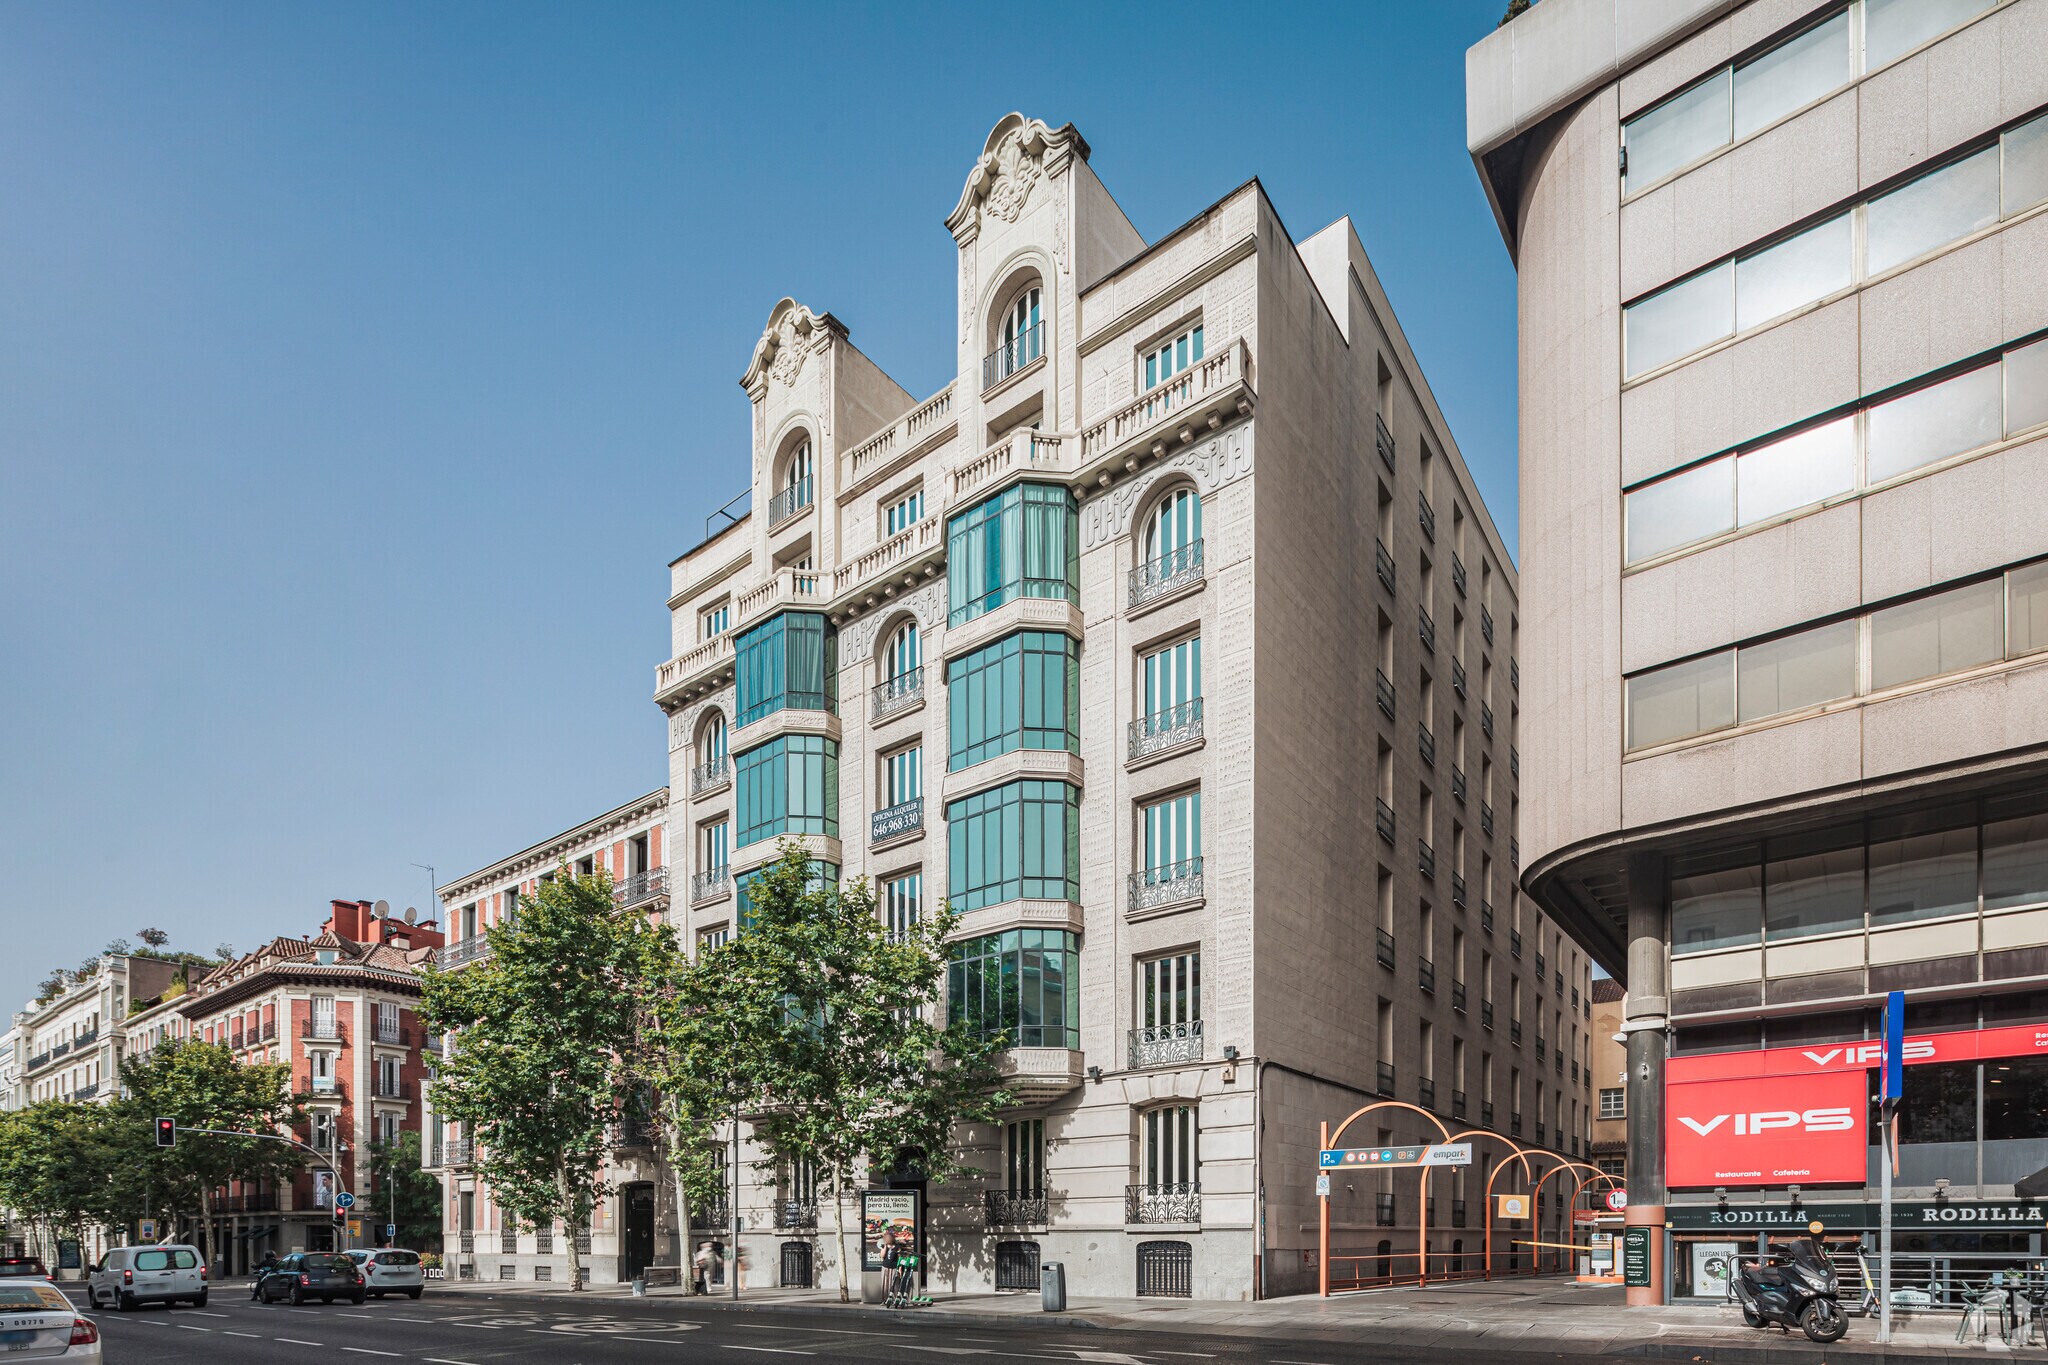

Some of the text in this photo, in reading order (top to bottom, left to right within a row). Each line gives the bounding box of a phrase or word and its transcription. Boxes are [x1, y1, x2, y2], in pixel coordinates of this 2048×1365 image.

[873, 802, 918, 822] OFICINA ALQUILER
[1676, 1107, 1855, 1137] VIPS
[1323, 1153, 1331, 1164] P
[1433, 1150, 1466, 1160] empark
[1715, 1168, 1811, 1178] Restaurante Cafetería
[891, 1195, 909, 1203] vacío,
[1710, 1210, 1809, 1223] RODILLA
[1922, 1207, 2044, 1221] RODILLA
